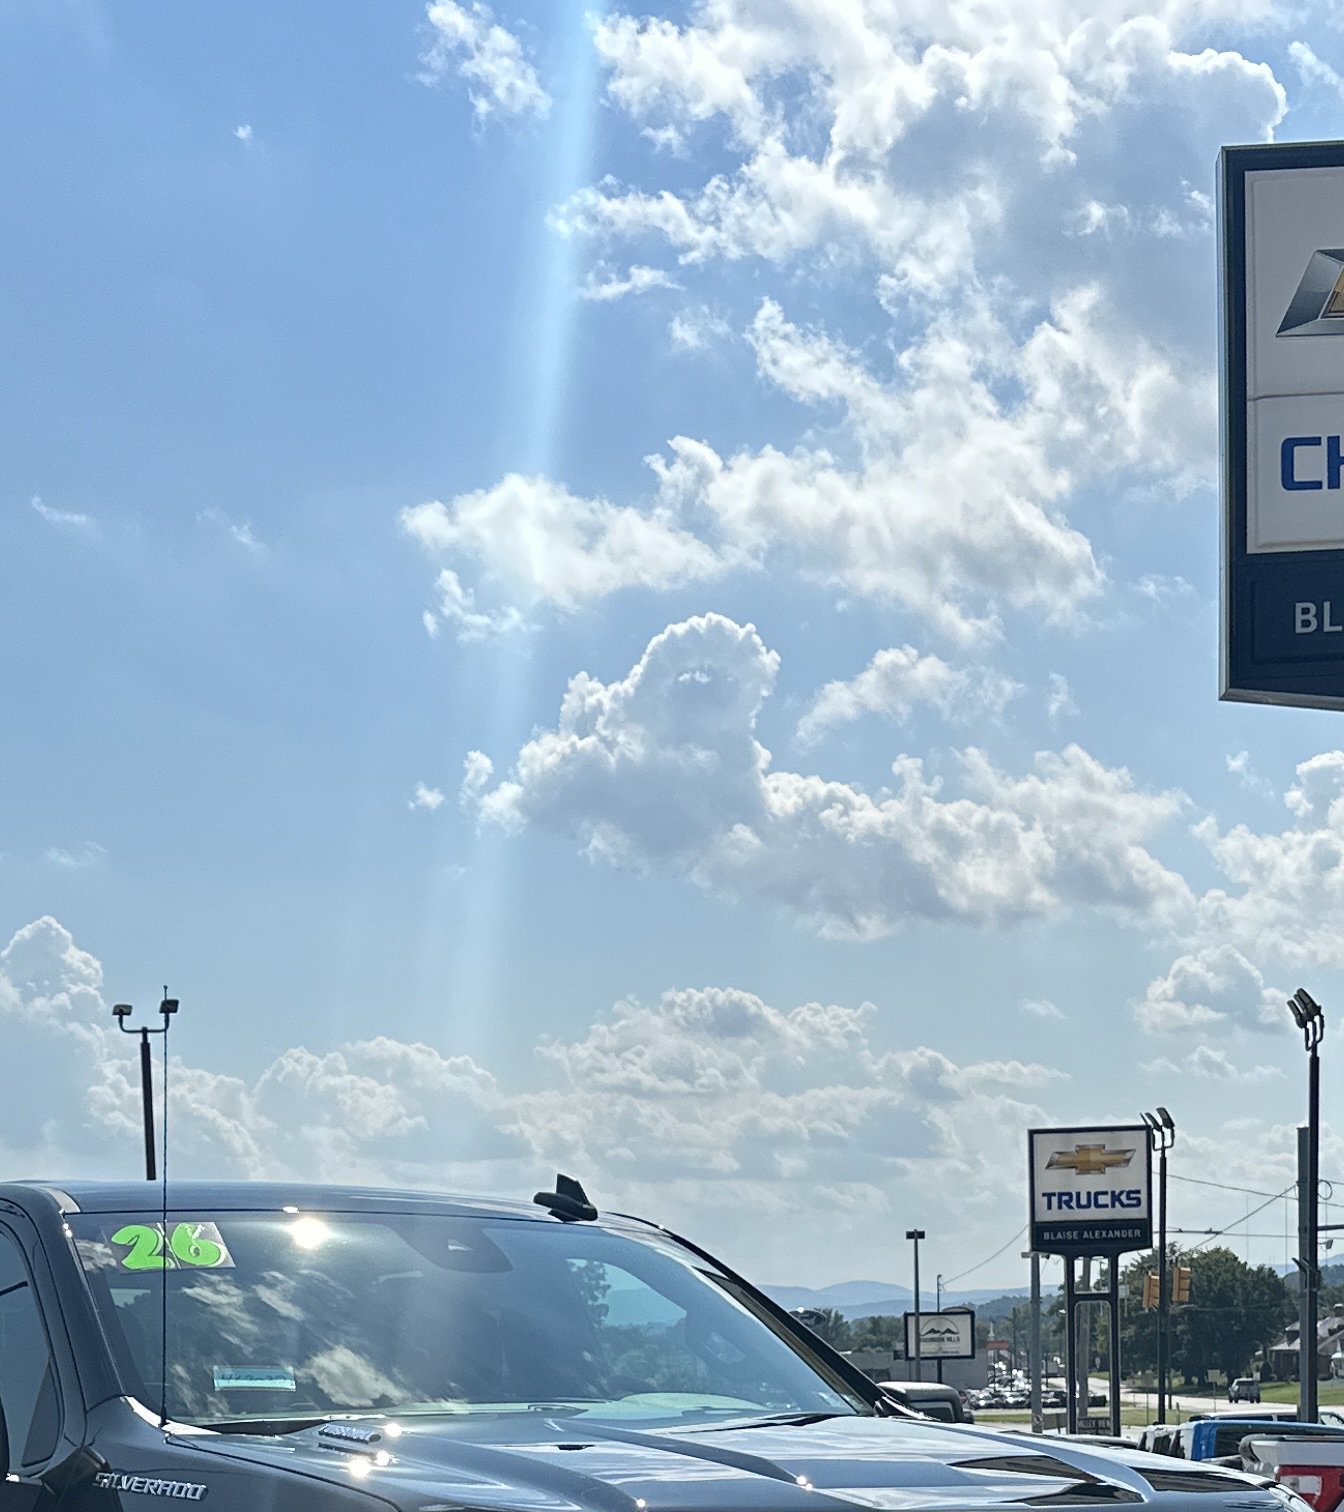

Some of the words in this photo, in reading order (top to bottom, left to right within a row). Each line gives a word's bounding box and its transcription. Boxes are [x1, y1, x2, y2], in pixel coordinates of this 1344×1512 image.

[1042, 1189, 1142, 1210] TRUCKS
[111, 1222, 226, 1270] 26
[1043, 1231, 1079, 1241] BLAISE
[1082, 1229, 1141, 1239] ALEXANDER
[93, 1472, 207, 1500] SILVERADO
